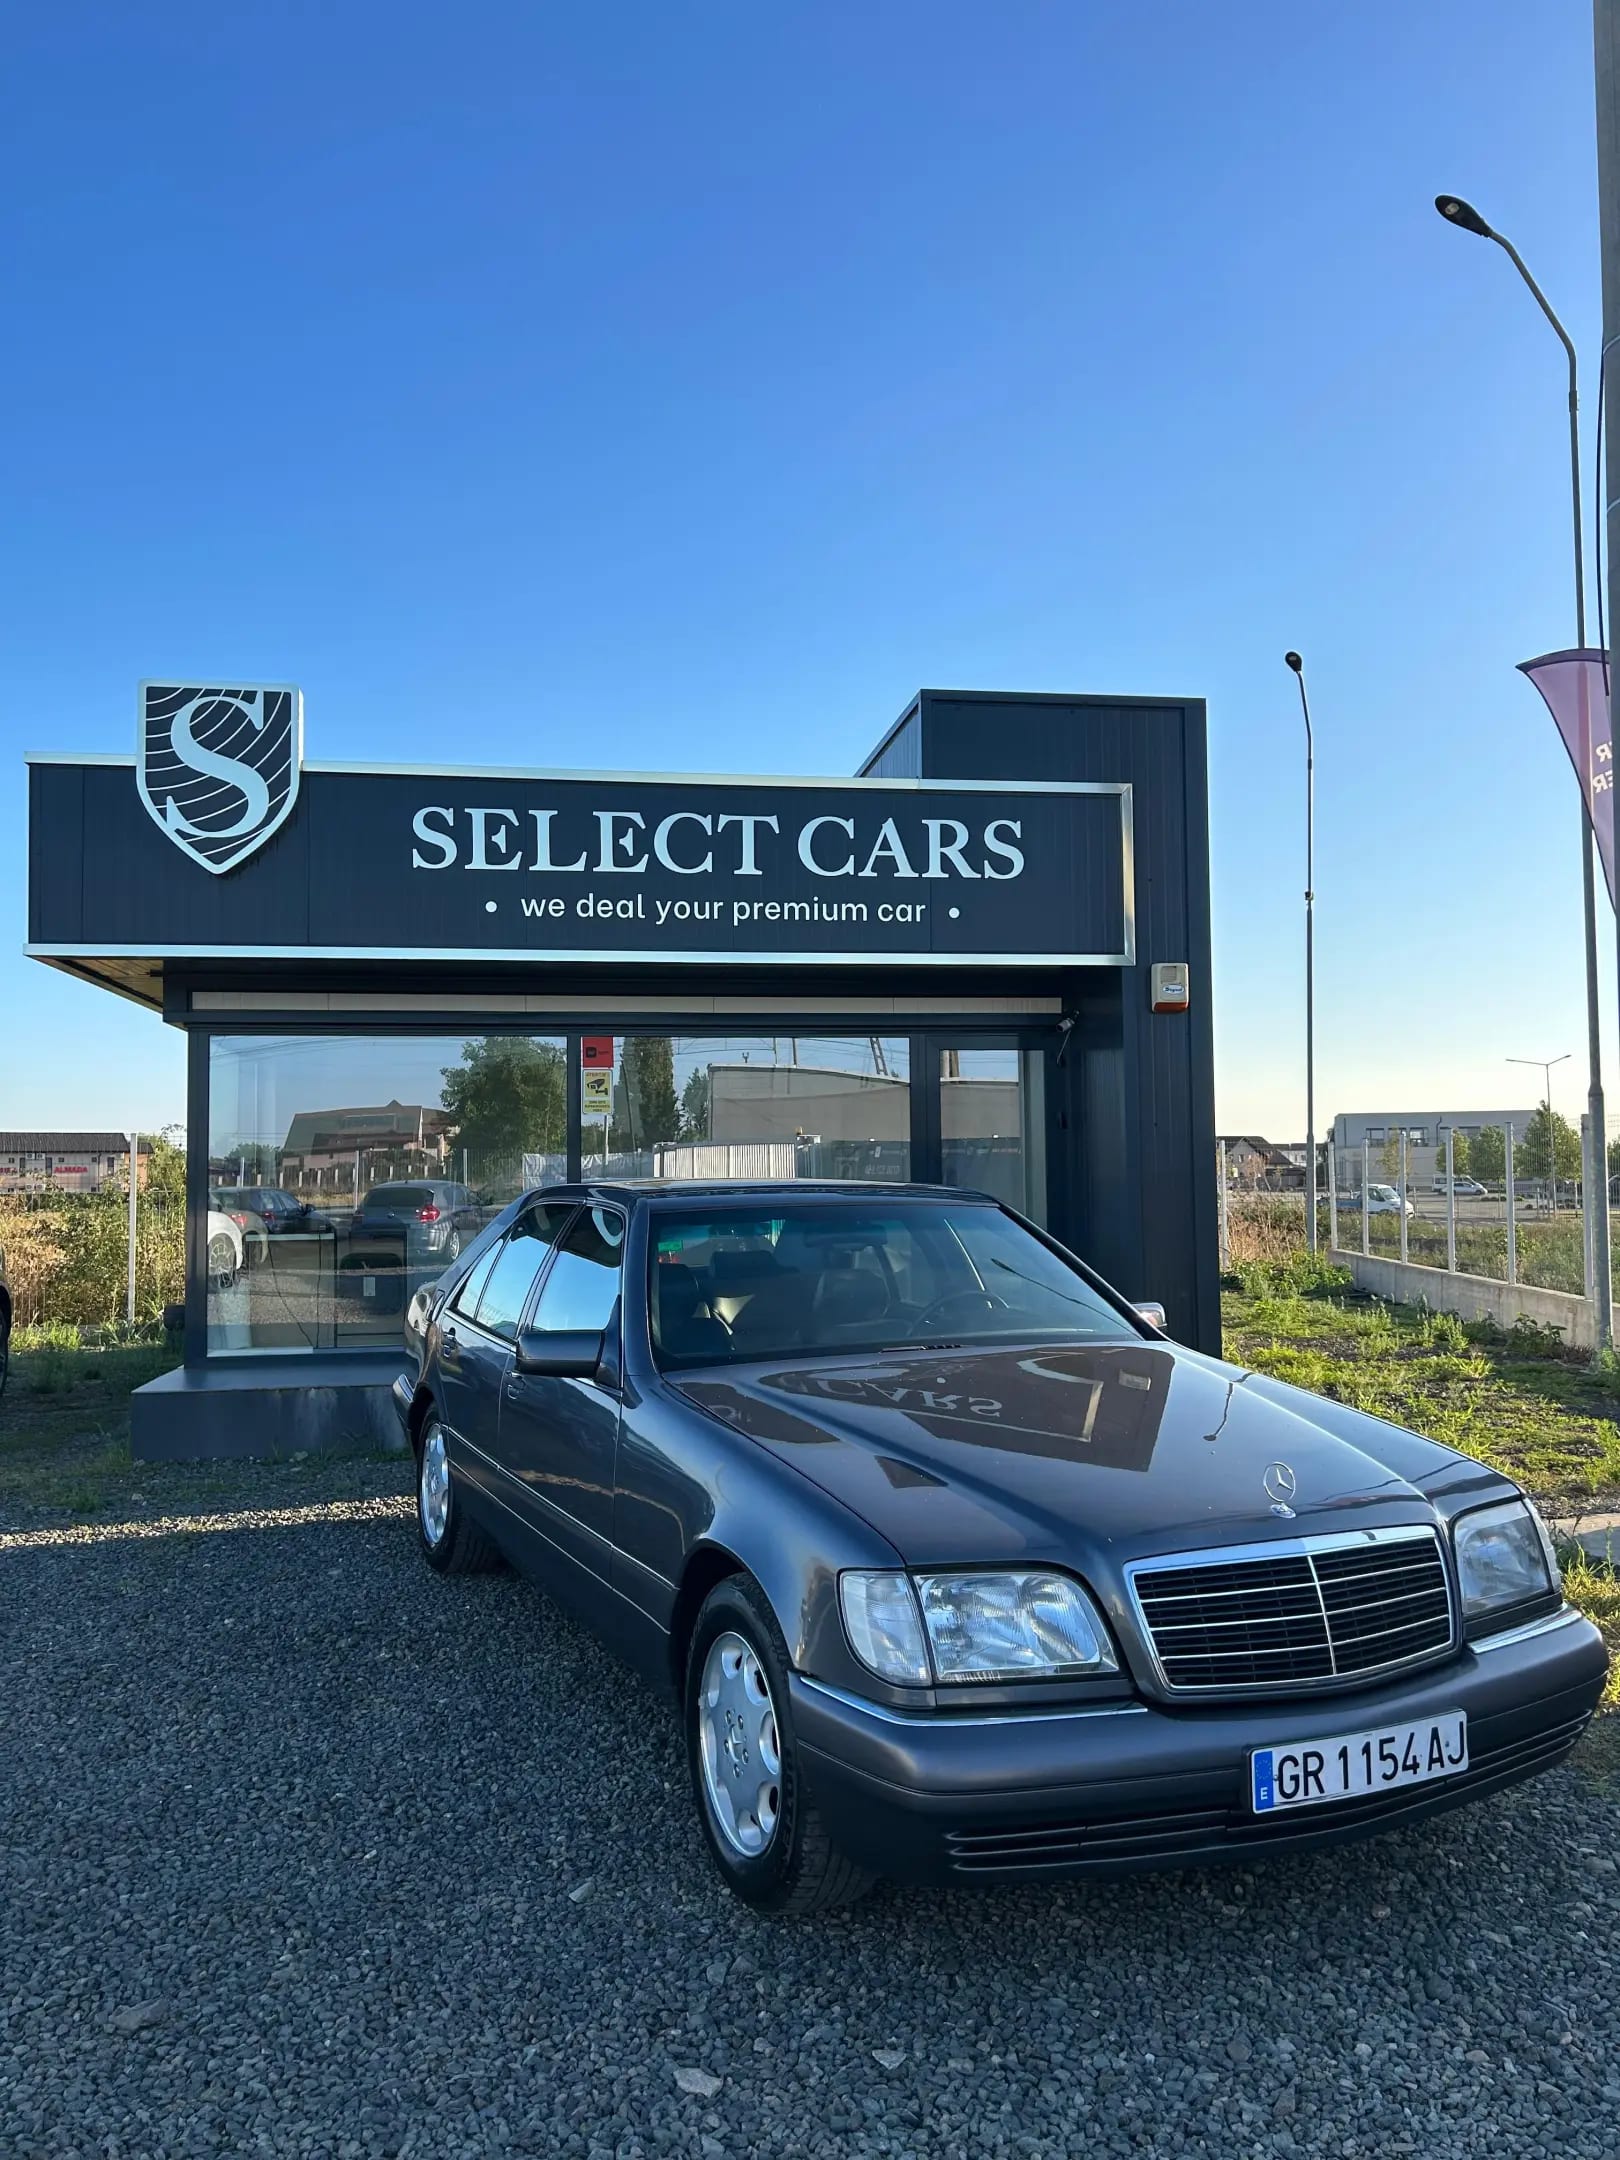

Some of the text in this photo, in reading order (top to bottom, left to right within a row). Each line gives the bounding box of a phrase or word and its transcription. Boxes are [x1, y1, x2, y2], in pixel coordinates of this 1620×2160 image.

[166, 690, 270, 838] S
[413, 806, 1025, 880] SELECT CARS
[520, 892, 926, 927] we deal your premium car
[1260, 1786, 1268, 1800] E
[1278, 1720, 1465, 1800] GR 1154 AJ
